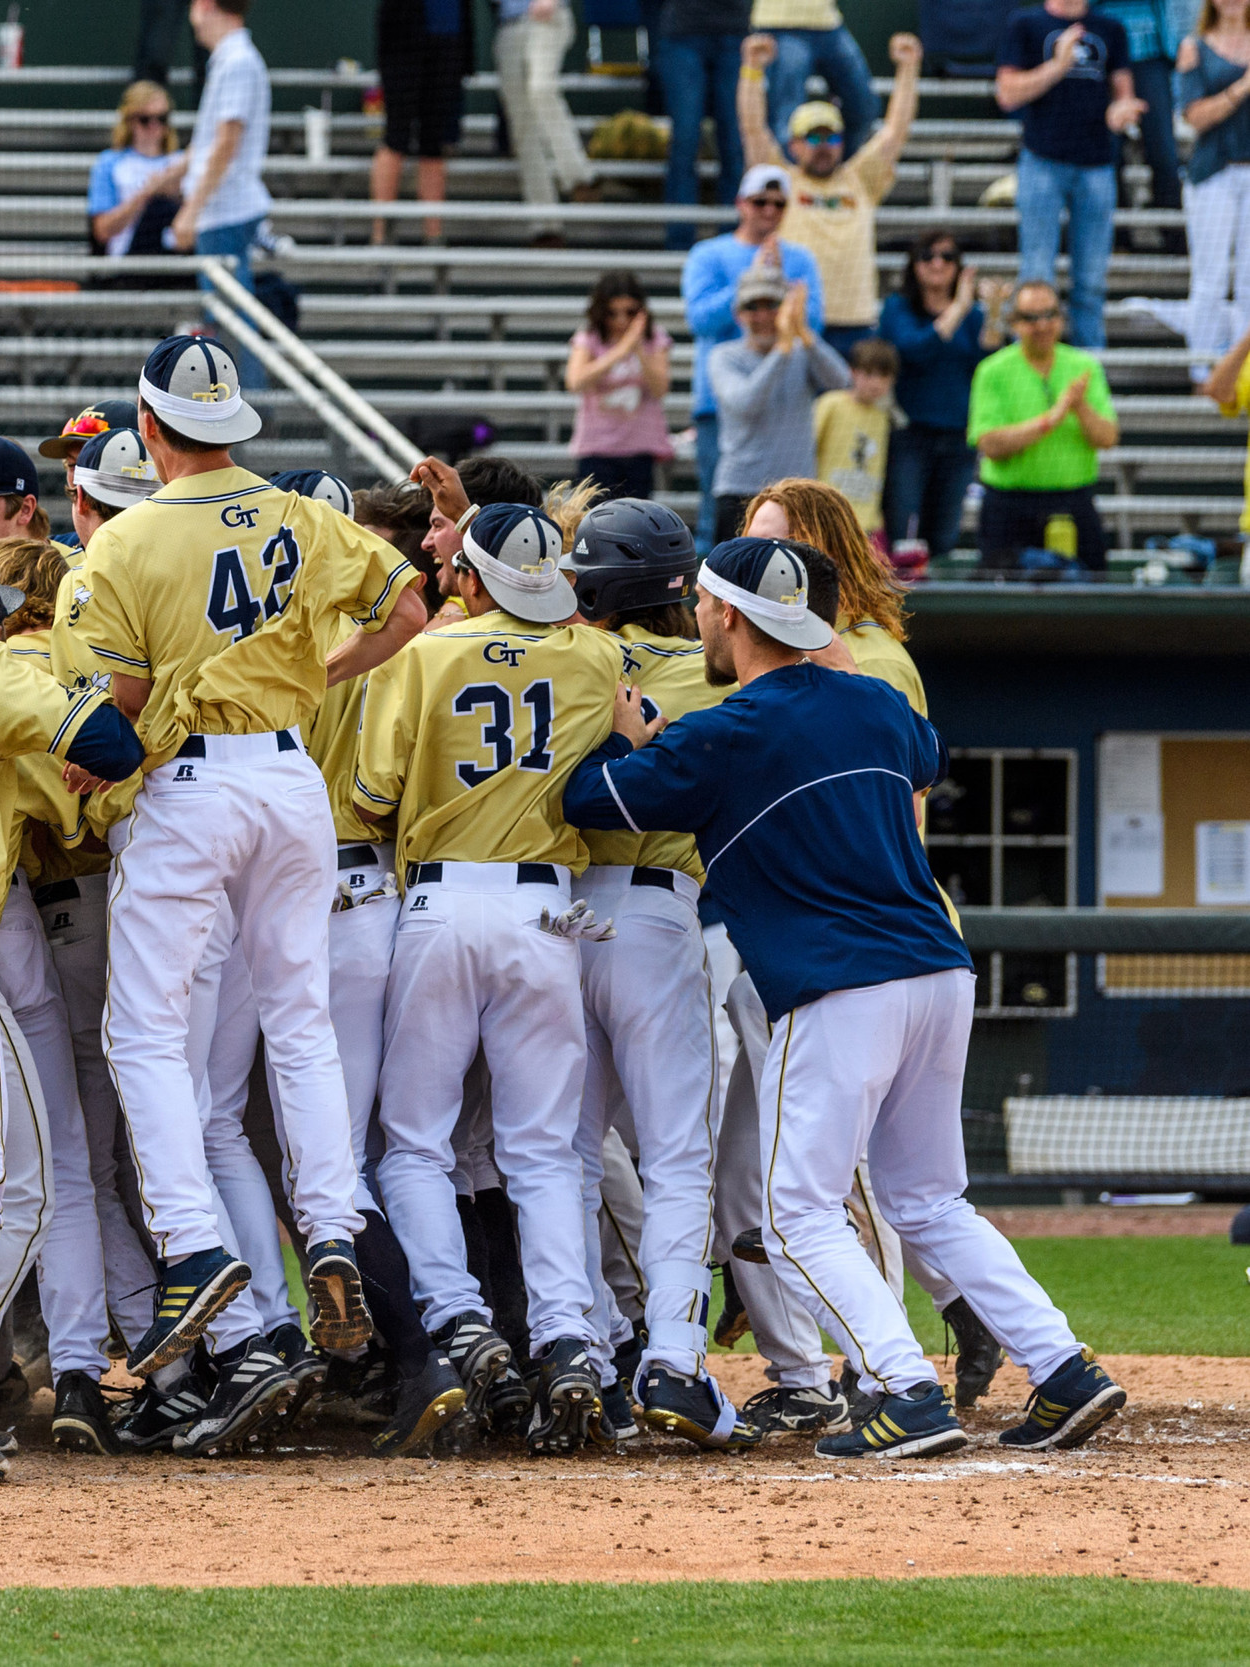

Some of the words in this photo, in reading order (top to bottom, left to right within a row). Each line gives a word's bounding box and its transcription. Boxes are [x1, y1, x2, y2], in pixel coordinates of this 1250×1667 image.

[220, 503, 260, 529] GT
[205, 523, 303, 646] 42
[483, 640, 526, 668] GT
[452, 677, 556, 791] 31
